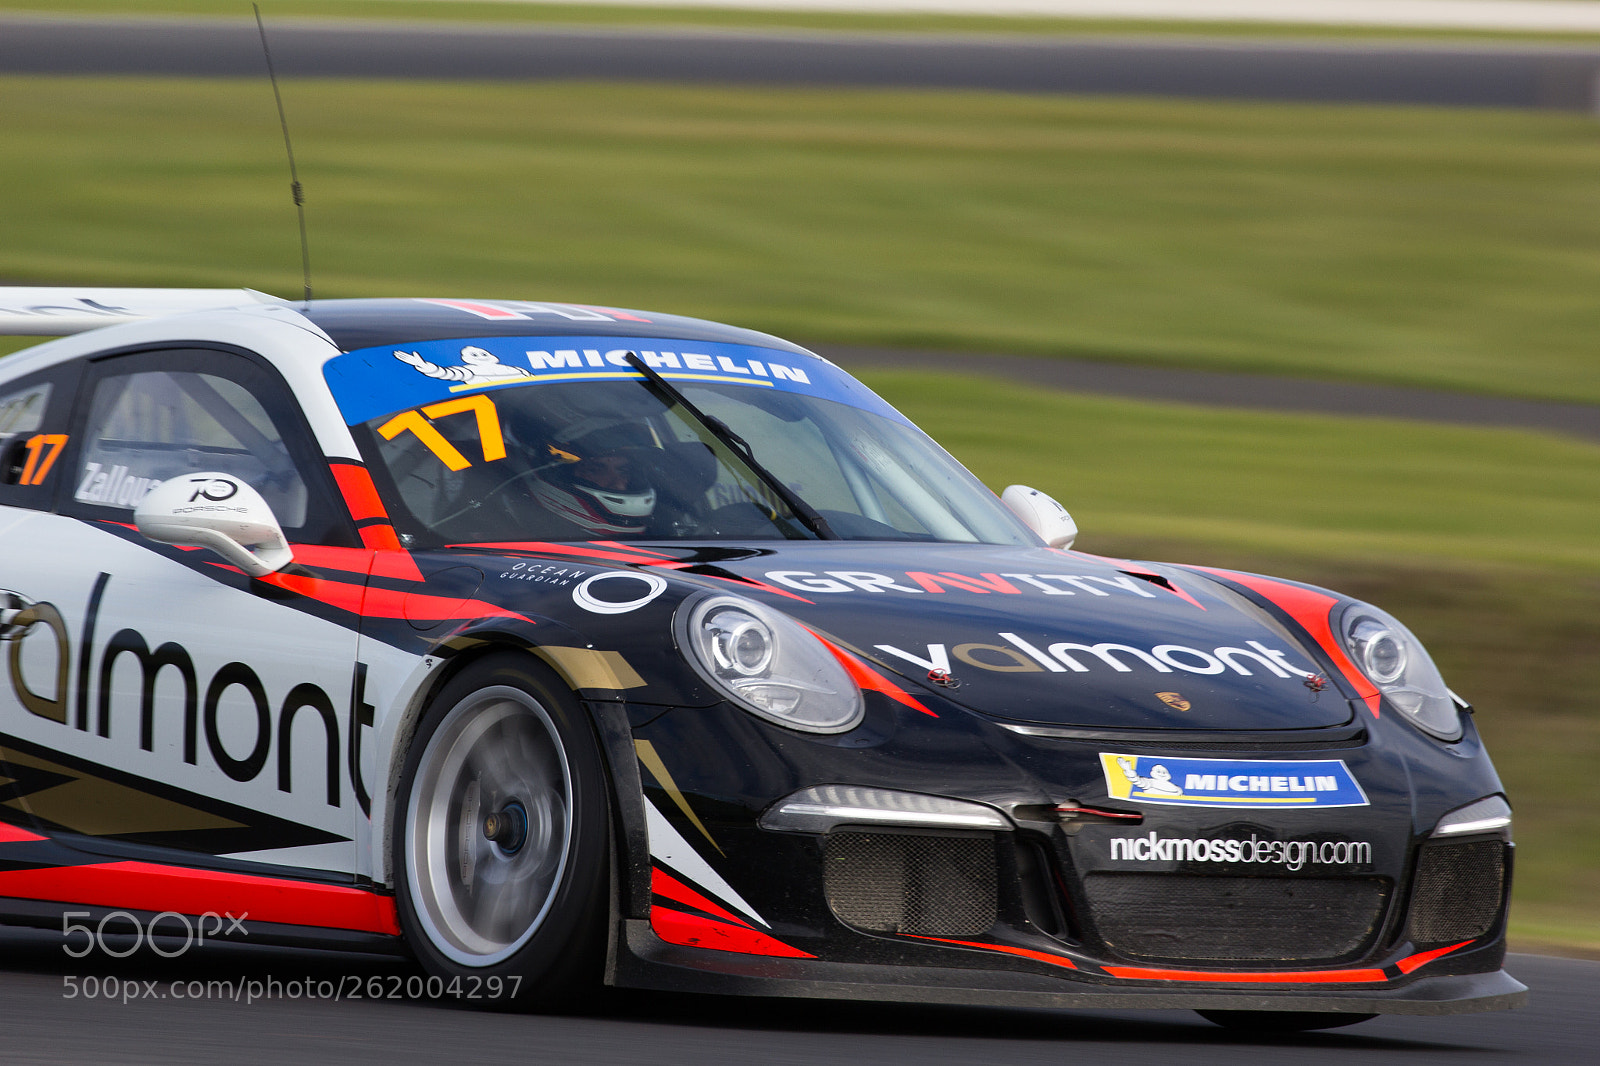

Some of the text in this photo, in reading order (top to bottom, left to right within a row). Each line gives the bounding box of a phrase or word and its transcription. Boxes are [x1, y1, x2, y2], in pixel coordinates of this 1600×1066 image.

[525, 349, 811, 385] MICHELIN
[377, 394, 507, 472] 17
[19, 434, 69, 485] 17
[499, 571, 570, 586] GUARDIAN
[512, 562, 586, 579] OCEAN
[764, 570, 1157, 598] GRAVITY
[872, 632, 1317, 679] valmont
[1184, 774, 1339, 792] MICHELIN
[1109, 831, 1372, 871] nickmossdesign.com
